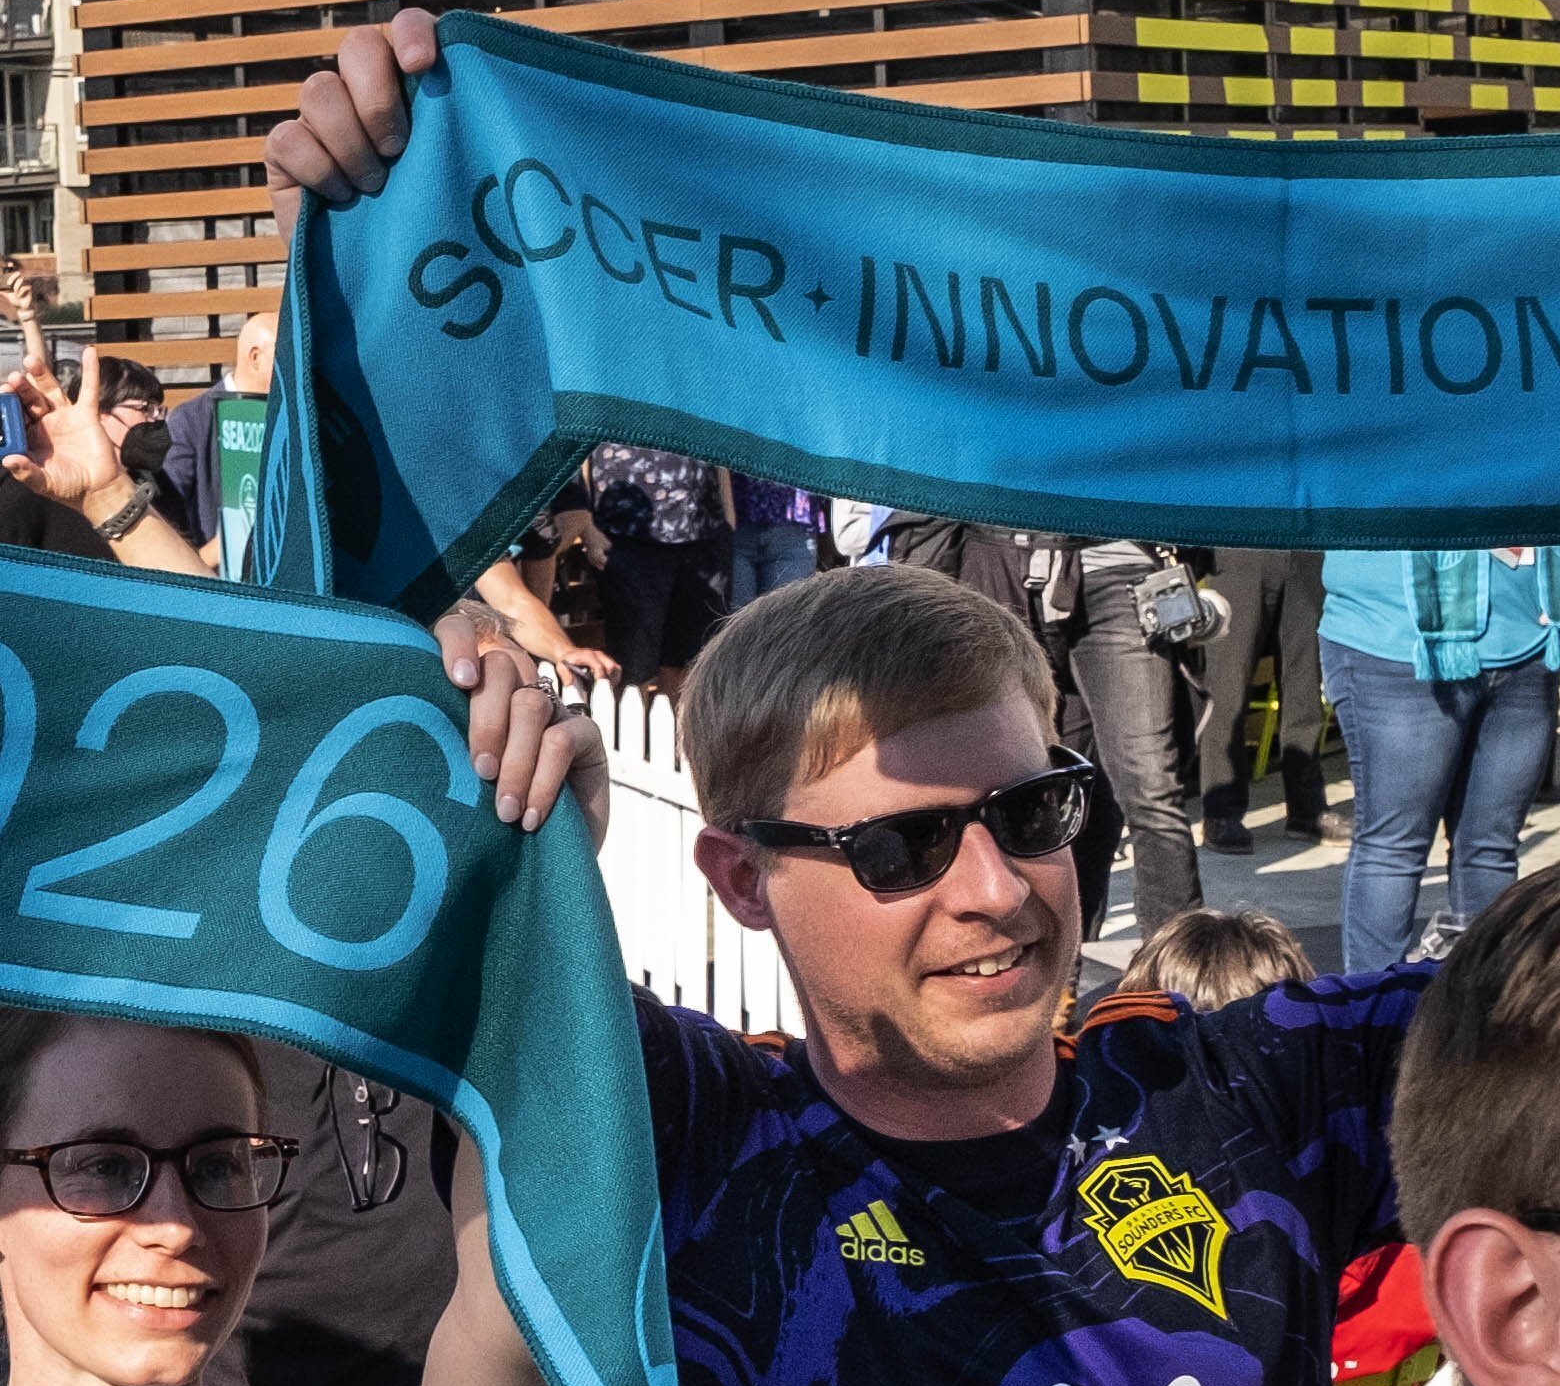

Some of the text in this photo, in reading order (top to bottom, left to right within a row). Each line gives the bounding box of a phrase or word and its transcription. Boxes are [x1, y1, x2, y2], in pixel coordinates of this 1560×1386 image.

[406, 156, 788, 344] SOCCER
[1117, 1205, 1207, 1255] SOUNDERS FC
